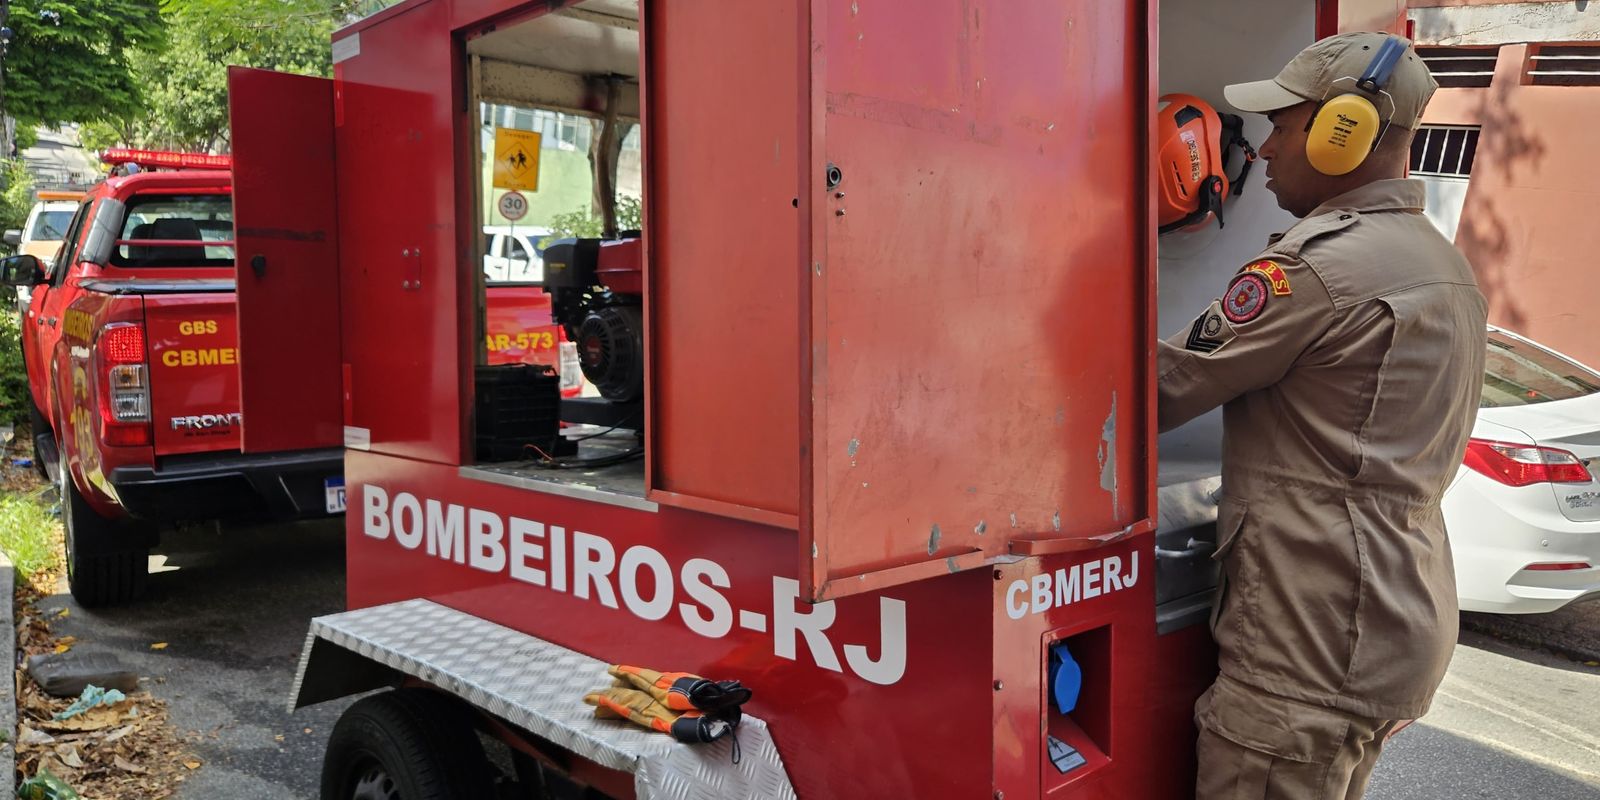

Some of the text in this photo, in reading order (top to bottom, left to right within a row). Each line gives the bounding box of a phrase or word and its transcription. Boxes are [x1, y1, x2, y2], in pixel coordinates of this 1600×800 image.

[504, 197, 522, 210] 30
[179, 320, 218, 336] GBS
[363, 483, 908, 686] BOMBEIROS-RJ
[1005, 550, 1139, 620] CBMERJ
